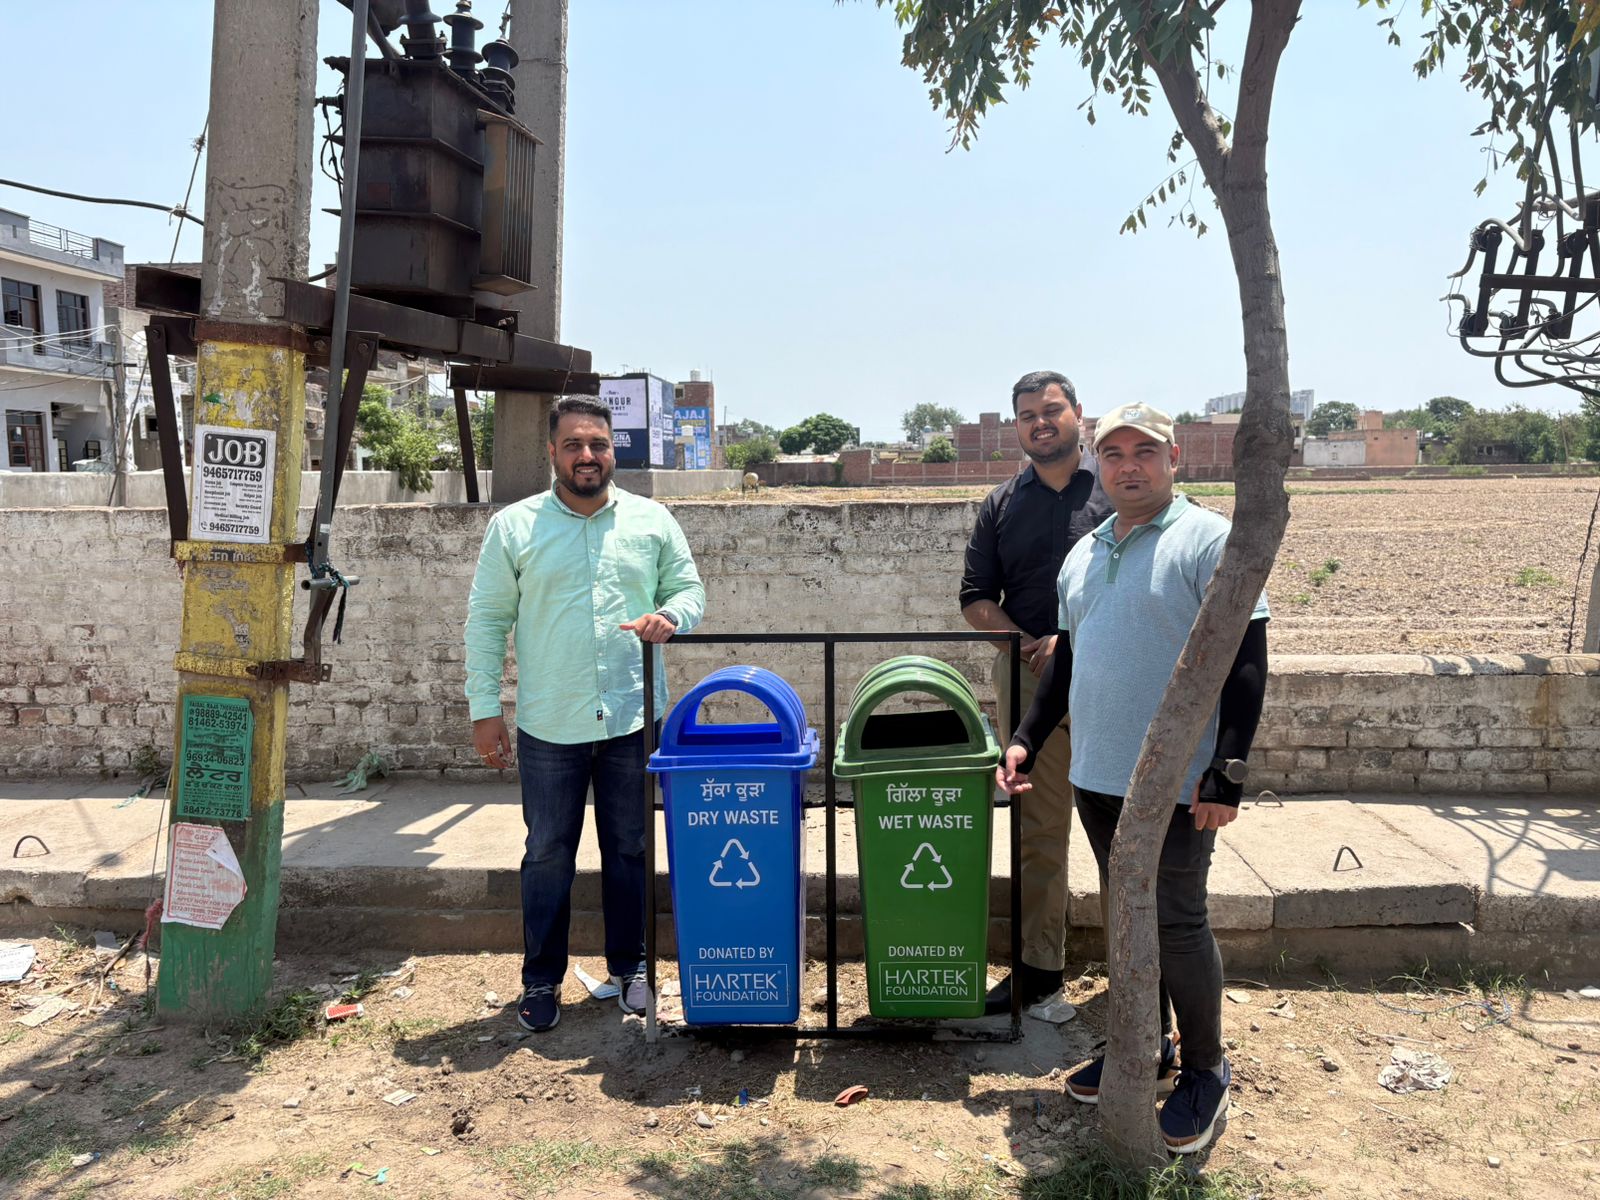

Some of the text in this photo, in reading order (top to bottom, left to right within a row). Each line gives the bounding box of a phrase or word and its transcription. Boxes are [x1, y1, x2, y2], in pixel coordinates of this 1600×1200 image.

[674, 409, 705, 419] AJAJ
[208, 438, 262, 466] JOB
[203, 466, 262, 482] 9465717759
[209, 522, 260, 534] 9465717759
[700, 778, 765, 801] ਸੁੱਕਾ ਕੂੜਾ
[886, 782, 962, 806] ਗਿੱਲਾ ਕੂੜਾ
[687, 809, 779, 826] DRY WASTE
[878, 814, 973, 830] WET WASTE
[699, 947, 774, 959] DONATED BY
[888, 945, 964, 957] DONATED BY
[695, 973, 777, 990] HARTEK
[885, 969, 967, 985] HARTEK
[696, 991, 779, 1001] FOUNDATION
[886, 986, 968, 996] FOUNDATION
